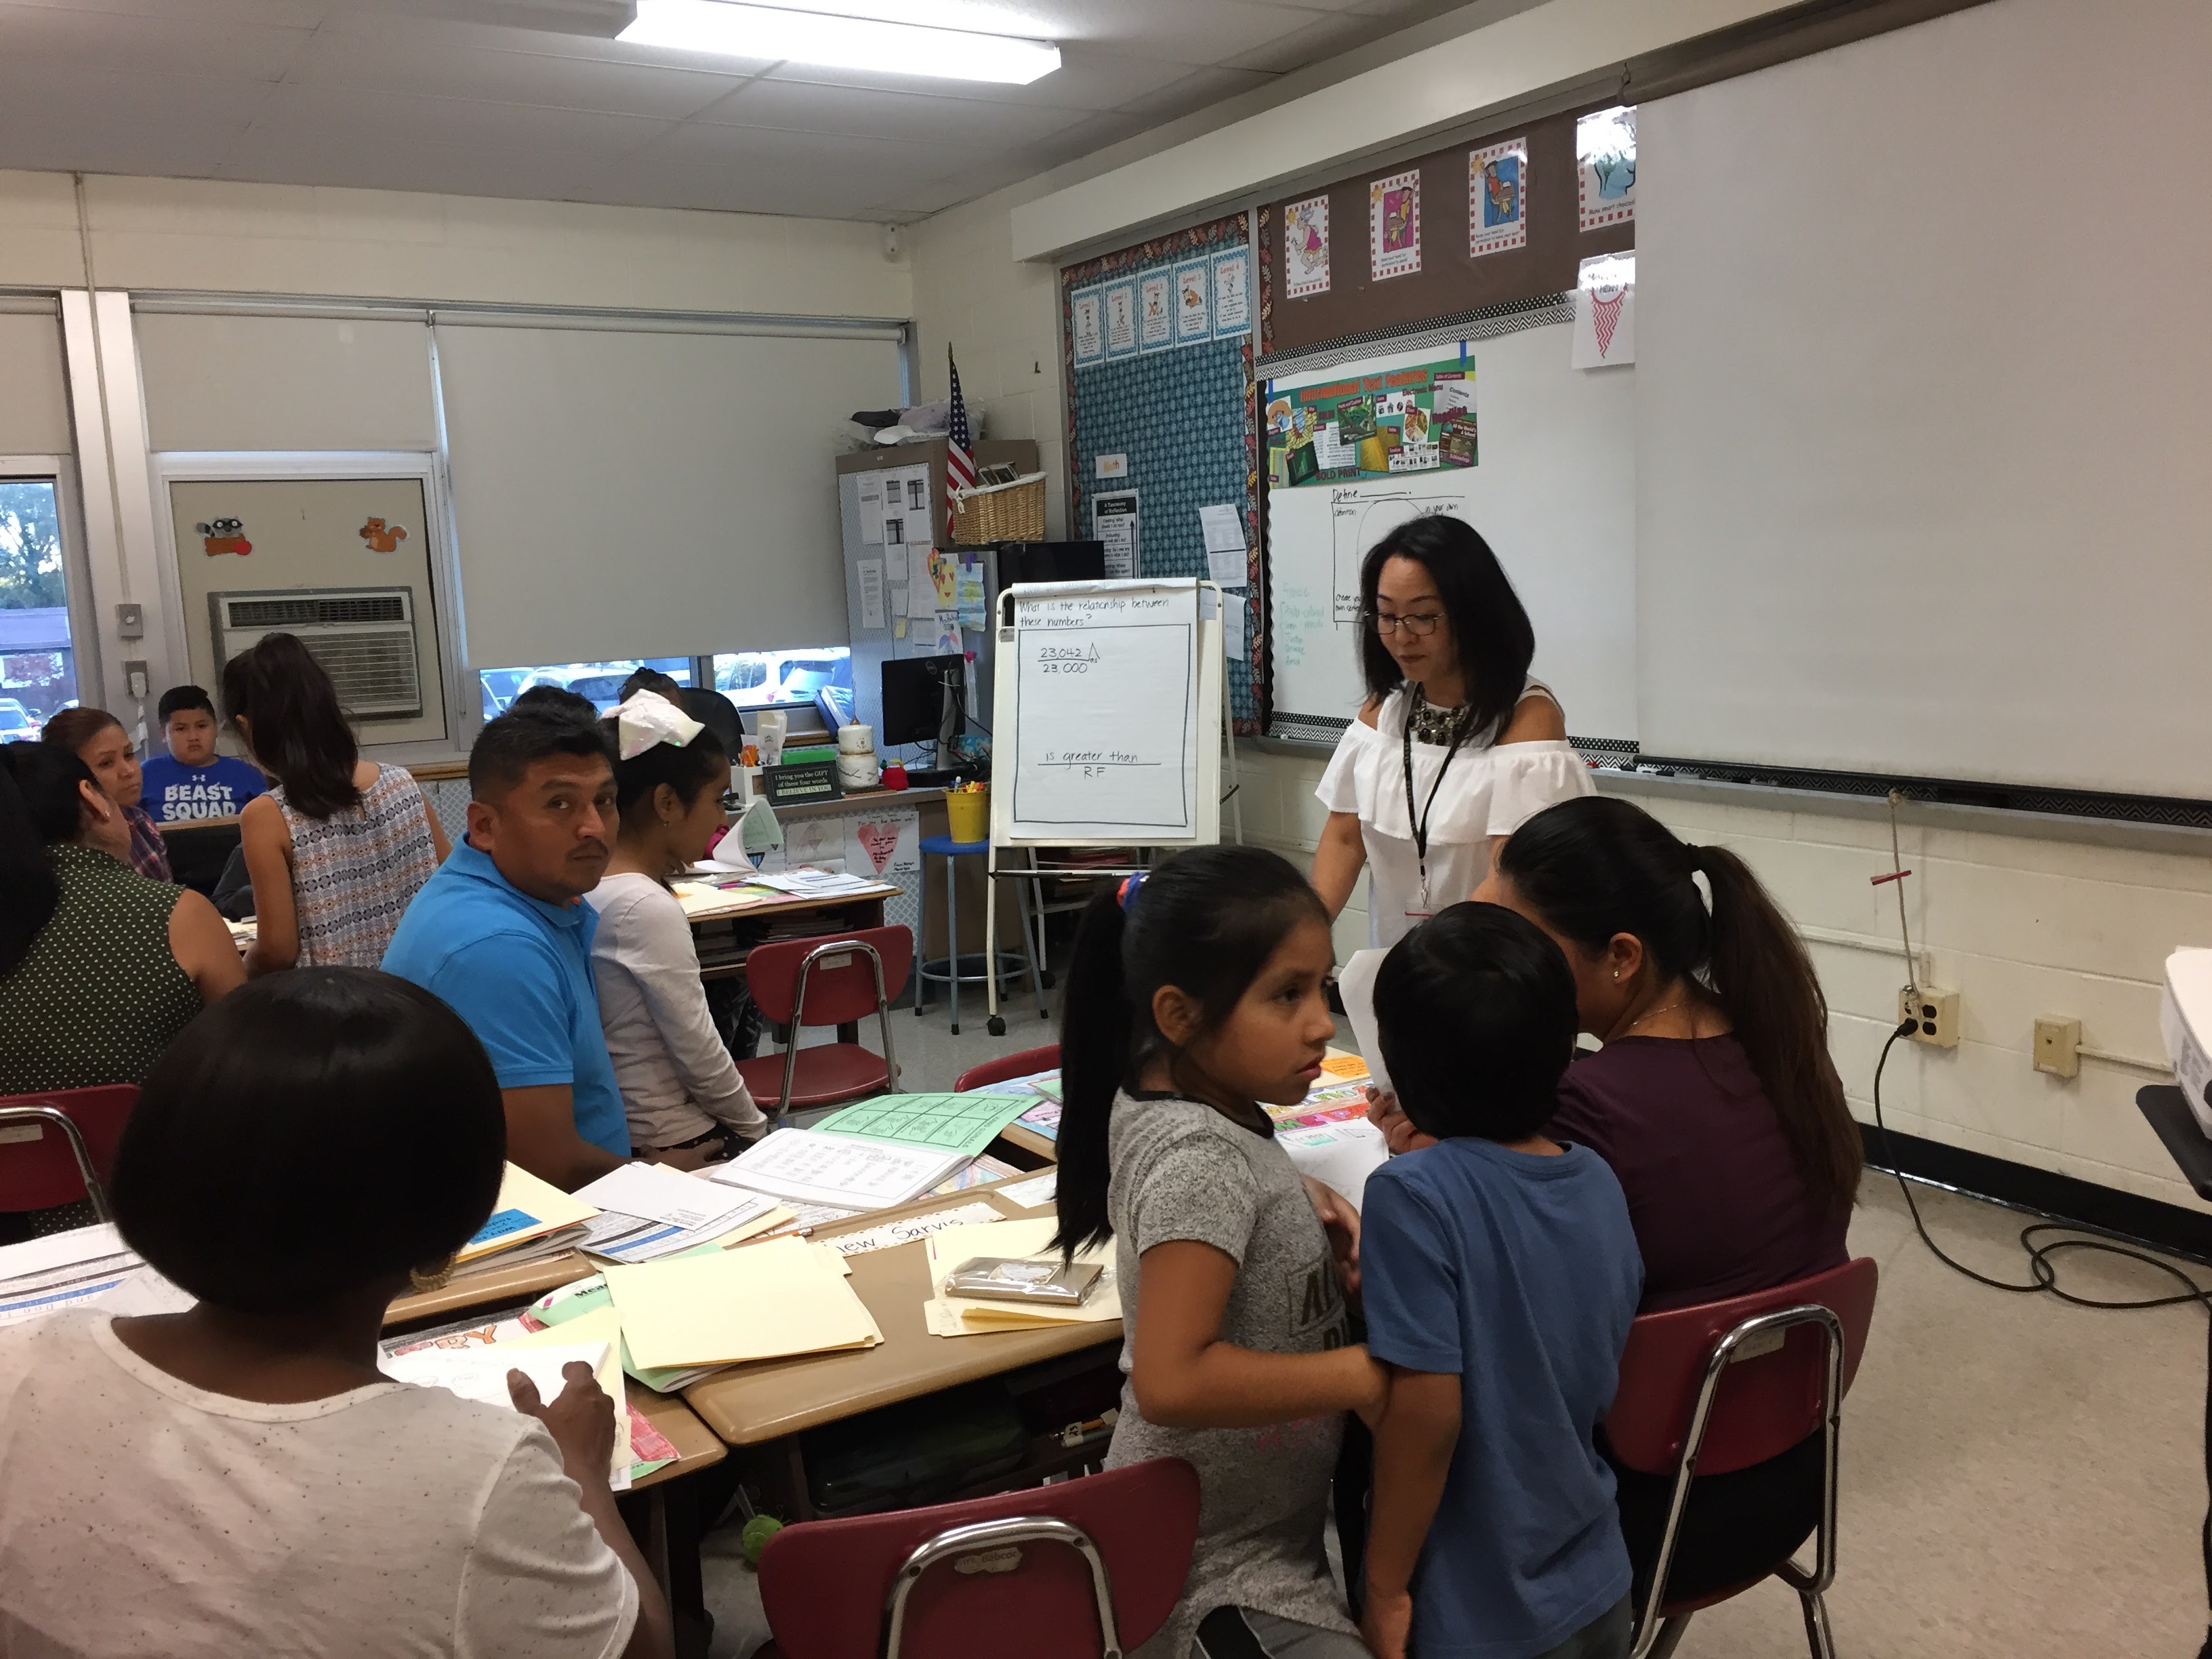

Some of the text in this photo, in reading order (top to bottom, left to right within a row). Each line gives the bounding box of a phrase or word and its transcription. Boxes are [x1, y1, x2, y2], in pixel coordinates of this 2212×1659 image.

[1601, 204, 1615, 212] smart
[1221, 266, 1234, 274] Level
[1183, 276, 1196, 284] Level
[1146, 285, 1158, 293] Level
[1111, 294, 1124, 302] Level
[1299, 368, 1428, 403] Informational Text Features
[1449, 387, 1470, 398] Contents
[1315, 467, 1361, 481] BOLD PRINT
[1333, 489, 1358, 503] Define
[1019, 597, 1169, 613] What is the relationship between
[1020, 616, 1042, 627] these
[1046, 751, 1138, 770] is greater than
[165, 782, 233, 802] BEAST
[162, 801, 237, 820] SQUAD
[891, 1218, 964, 1240] Sarvis
